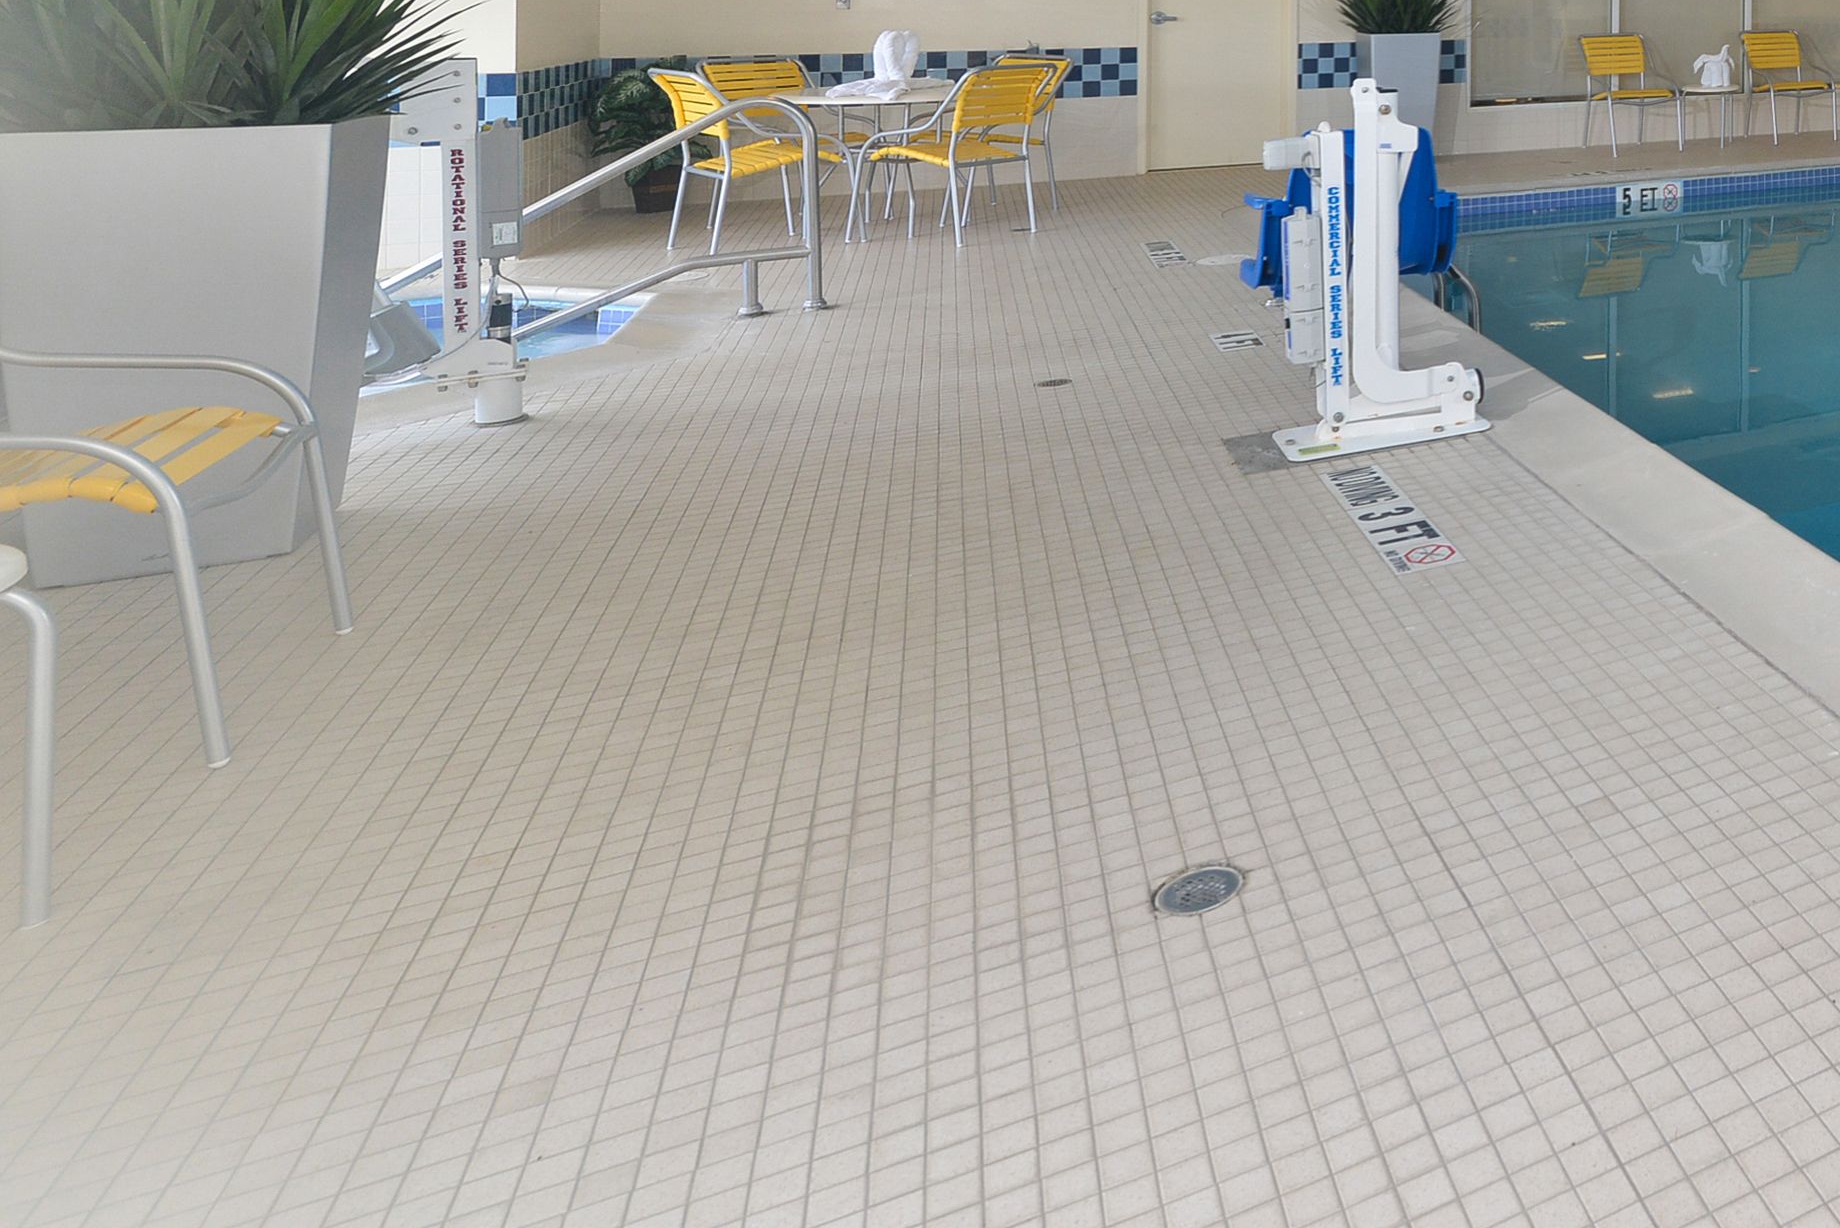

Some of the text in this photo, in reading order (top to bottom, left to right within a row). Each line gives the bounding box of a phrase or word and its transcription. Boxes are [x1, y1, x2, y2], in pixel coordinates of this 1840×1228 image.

[450, 149, 468, 332] ROTATIONAL SERIES LIFT
[1327, 187, 1343, 385] COMMERCIAL SERIES LIFT
[1358, 506, 1415, 521] 3
[1368, 520, 1440, 545] FT
